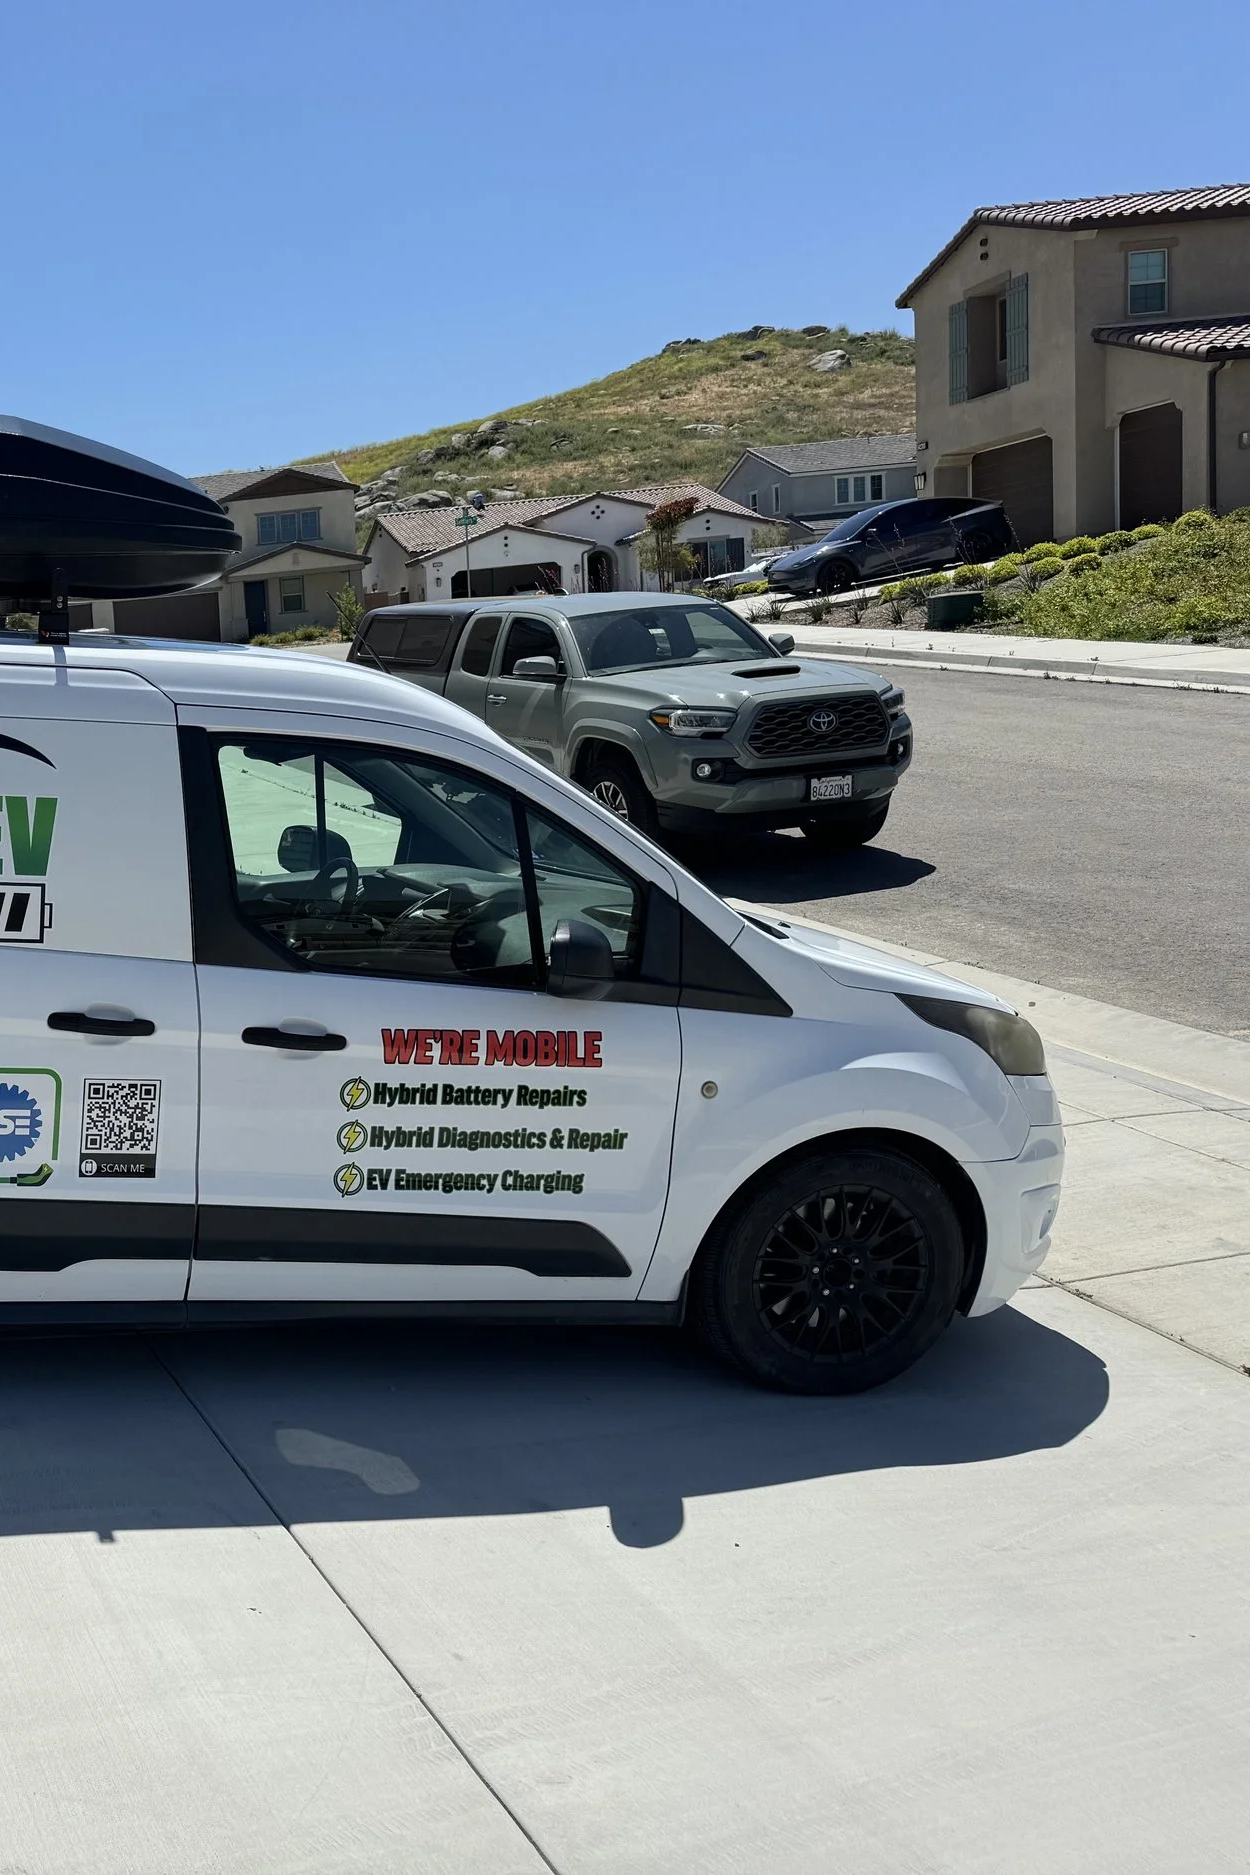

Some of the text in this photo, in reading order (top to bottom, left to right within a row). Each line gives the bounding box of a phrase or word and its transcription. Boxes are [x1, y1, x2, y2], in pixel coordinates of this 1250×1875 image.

[381, 1028, 603, 1068] WE'RE MOBILE
[372, 1082, 588, 1109] Hybrid Battery Repairs
[369, 1125, 628, 1152] Hybrid Diagnostics & Repair
[100, 1163, 146, 1173] SCAN ME
[366, 1168, 585, 1194] EV Emergency Charging
